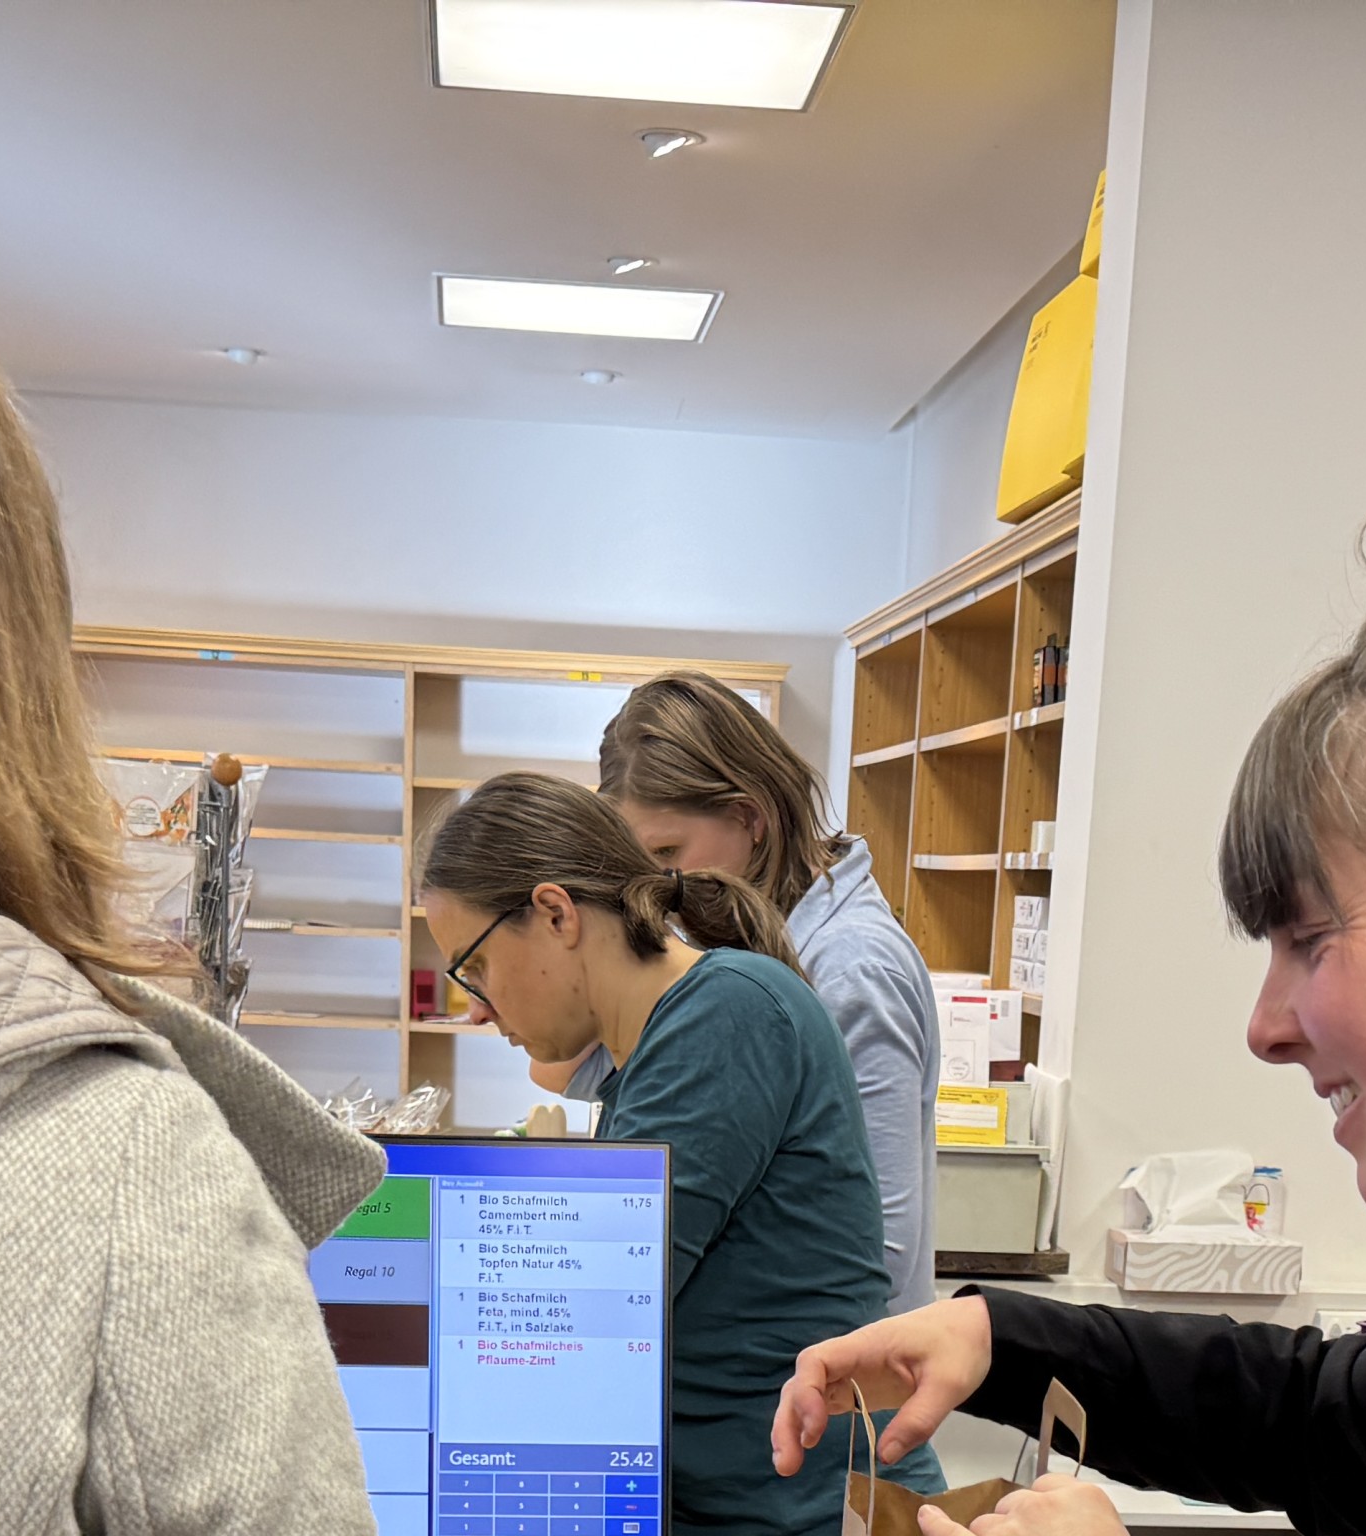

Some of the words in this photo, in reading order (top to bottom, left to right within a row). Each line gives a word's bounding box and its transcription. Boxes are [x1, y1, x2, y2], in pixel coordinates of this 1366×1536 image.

[459, 1194, 465, 1204] 1
[479, 1195, 499, 1205] Bio
[502, 1195, 568, 1206] Schafmilch
[622, 1198, 652, 1209] 11,75
[356, 1202, 382, 1215] egal
[384, 1203, 391, 1213] 5
[478, 1210, 547, 1221] Camembert
[478, 1224, 503, 1235] 45%
[459, 1243, 465, 1253] 1
[478, 1243, 498, 1254] Bio
[502, 1244, 568, 1255] Schafmilch
[627, 1247, 651, 1258] 4,47
[479, 1258, 518, 1270] Topfen
[522, 1259, 554, 1269] Natur
[557, 1259, 582, 1270] 45%
[344, 1265, 377, 1279] Regal
[382, 1266, 395, 1277] 10
[458, 1292, 464, 1301] 1
[478, 1292, 498, 1303] Bio
[501, 1293, 567, 1304] Schafmilch
[627, 1295, 651, 1306] 4,20
[478, 1307, 507, 1318] Feta,
[510, 1307, 543, 1318] mind.
[546, 1308, 571, 1318] 45%
[511, 1322, 522, 1332] in
[525, 1322, 574, 1333] Salzlake
[458, 1340, 464, 1350] 1
[477, 1340, 497, 1350] Bio
[501, 1340, 583, 1352] Schafmilcheis
[627, 1342, 651, 1353] 5,00
[477, 1354, 556, 1366] Pflaume-Zimt
[449, 1450, 516, 1466] Gesamt:
[609, 1452, 654, 1467] 25.42
